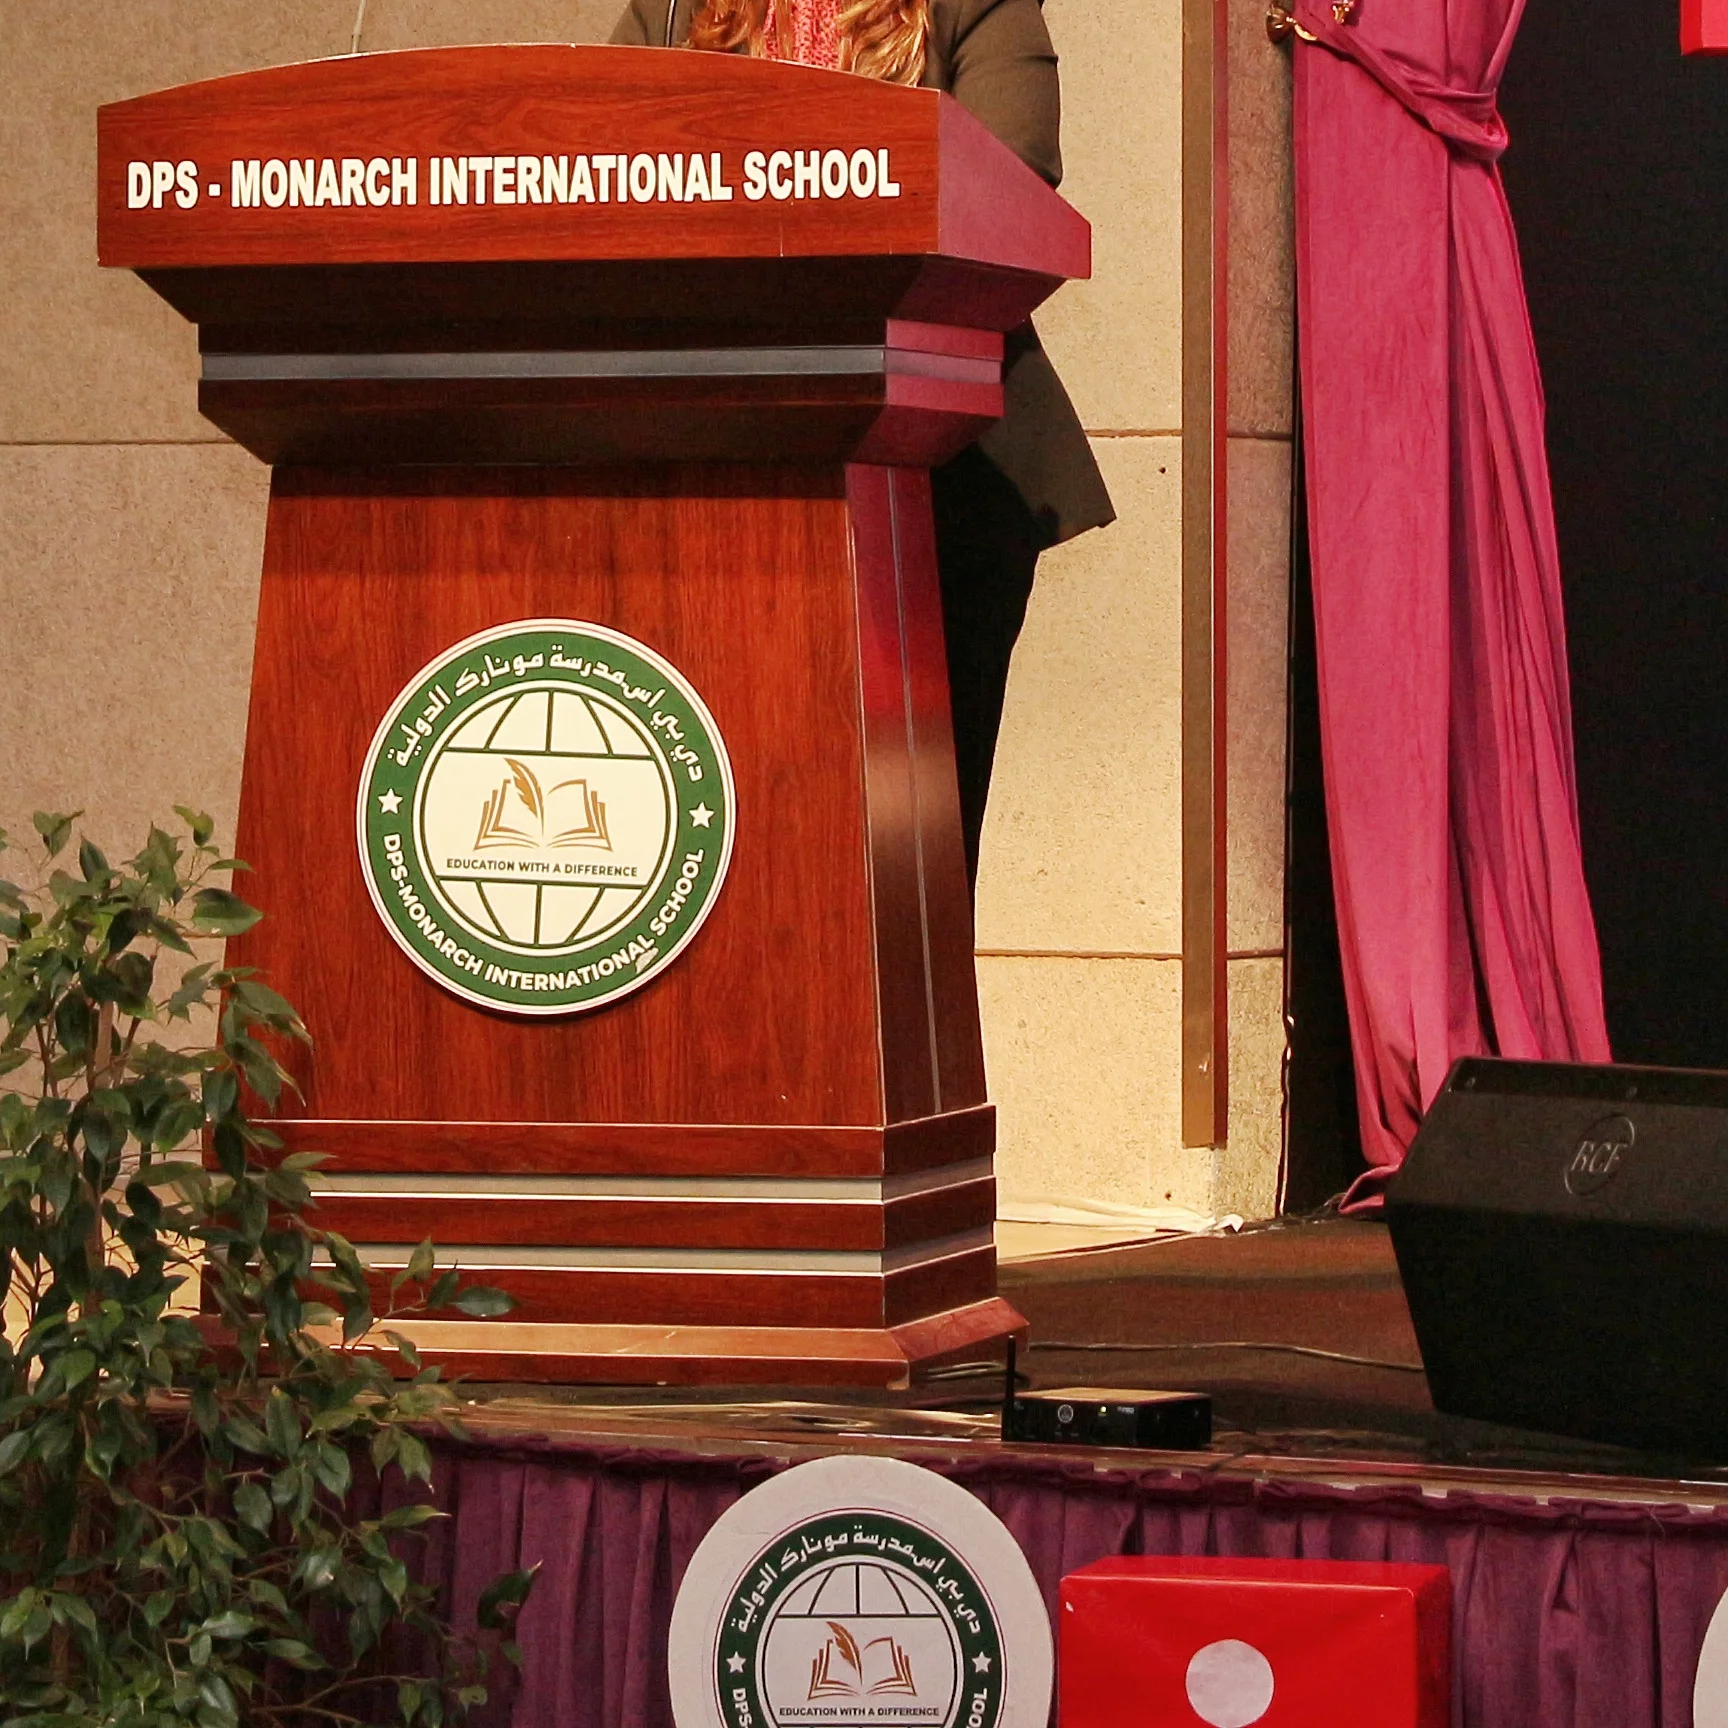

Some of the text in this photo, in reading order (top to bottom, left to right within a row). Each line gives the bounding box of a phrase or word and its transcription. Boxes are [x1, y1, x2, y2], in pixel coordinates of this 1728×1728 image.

[126, 161, 199, 209] DPS
[230, 157, 418, 207] MONARCH
[428, 152, 732, 205] INTERNATIONAL
[743, 148, 900, 200] SCHOOL
[446, 858, 638, 877] EDUCATION WITH A DIFFERENCE
[484, 933, 654, 992] INTERNATIONAL
[650, 848, 704, 938] SCHOOL
[779, 1707, 940, 1716] EDUCATION WITH A DIFFERENCE
